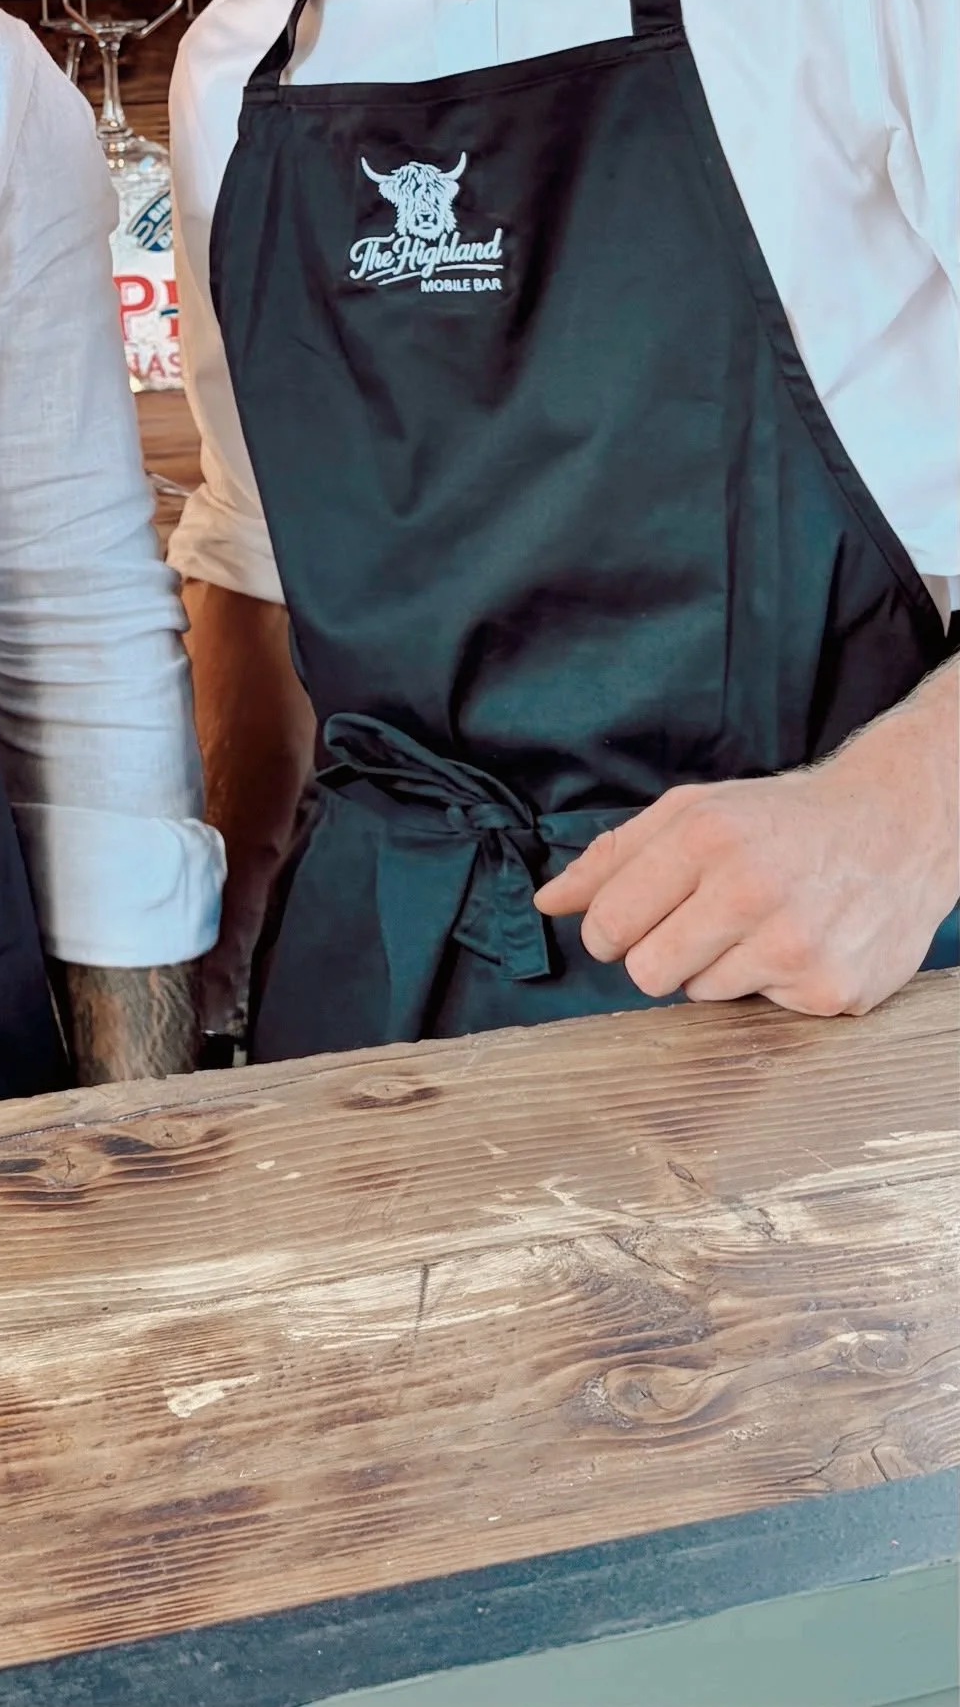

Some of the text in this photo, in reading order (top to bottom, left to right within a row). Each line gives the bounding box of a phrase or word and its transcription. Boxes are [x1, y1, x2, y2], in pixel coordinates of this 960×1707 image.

[349, 228, 503, 280] The Highland
[421, 277, 503, 293] MOBILE BAR
